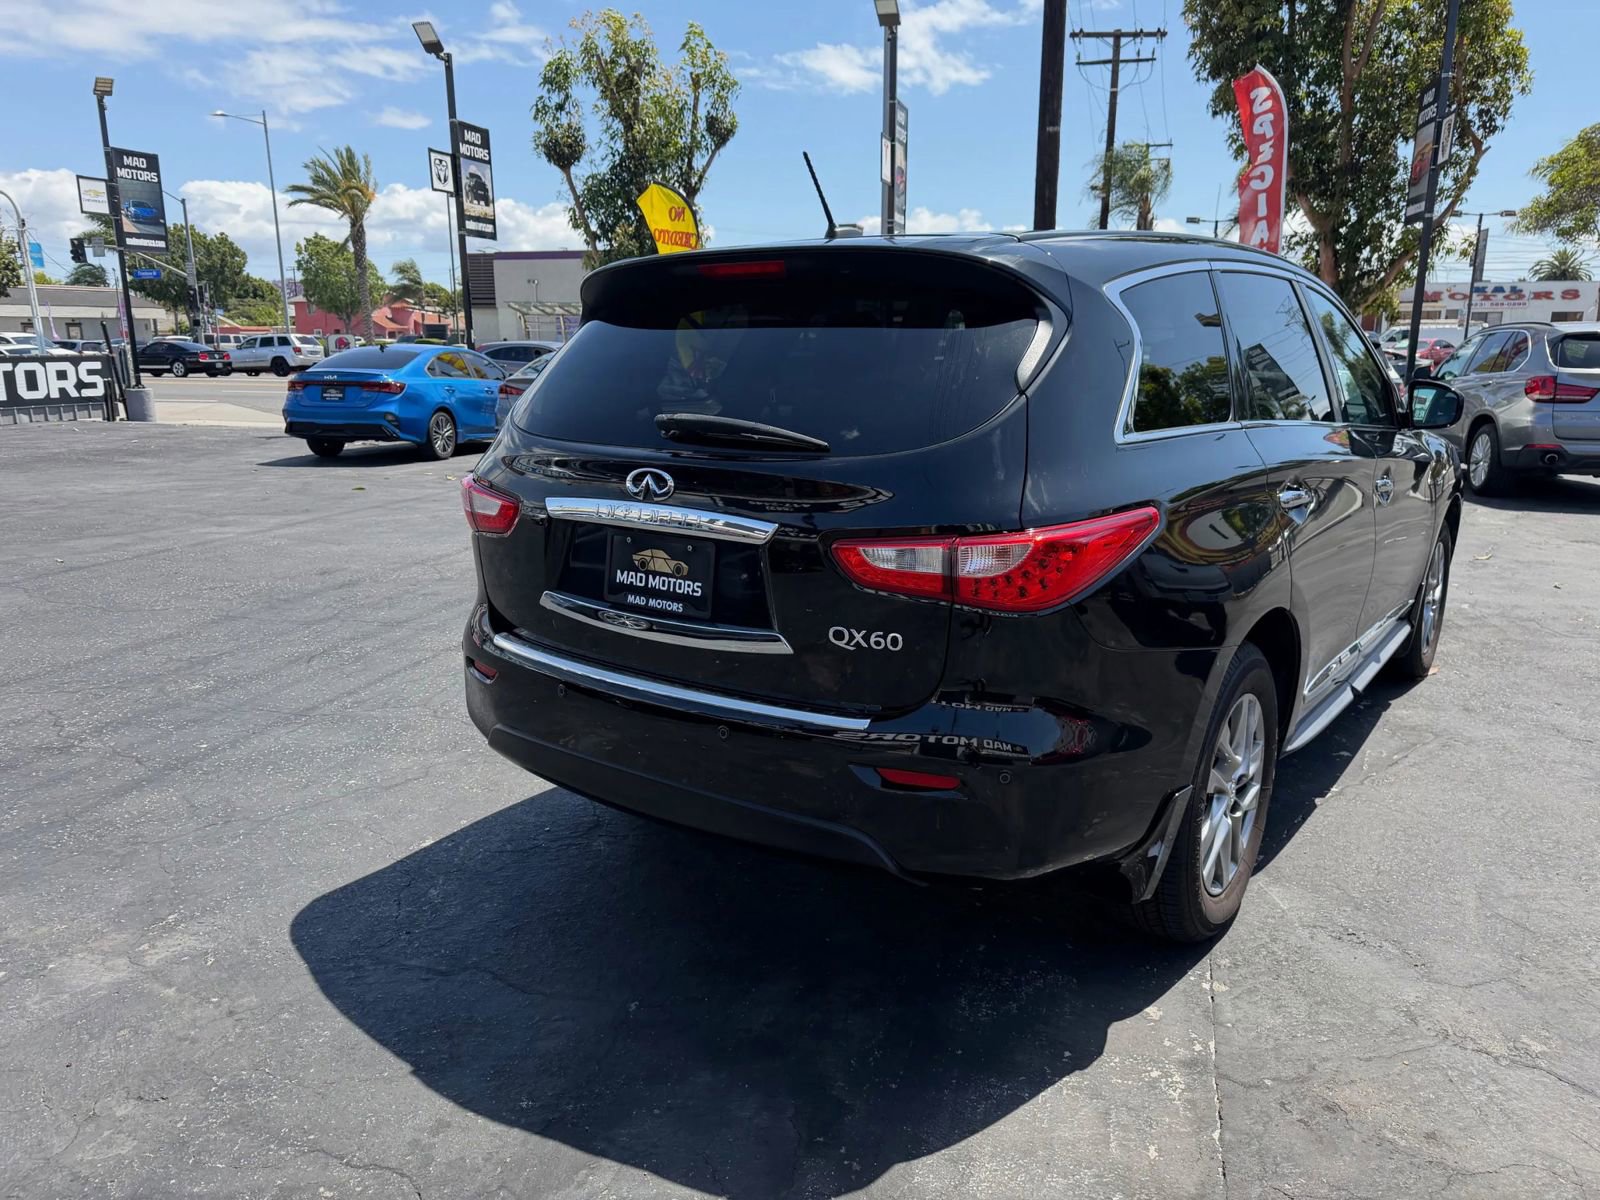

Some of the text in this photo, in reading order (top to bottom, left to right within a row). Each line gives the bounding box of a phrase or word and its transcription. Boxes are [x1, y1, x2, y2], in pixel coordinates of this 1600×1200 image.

[464, 129, 482, 145] MAD
[460, 142, 489, 161] MOTORS
[123, 155, 147, 168] MAD
[116, 167, 158, 182] MOTORS
[1423, 289, 1581, 301] MOTORS
[1472, 285, 1523, 294] KAL
[594, 503, 705, 530] INFINITI
[616, 569, 702, 597] MAD MOTORS
[627, 594, 683, 613] MAD MOTORS
[828, 626, 904, 651] QX60
